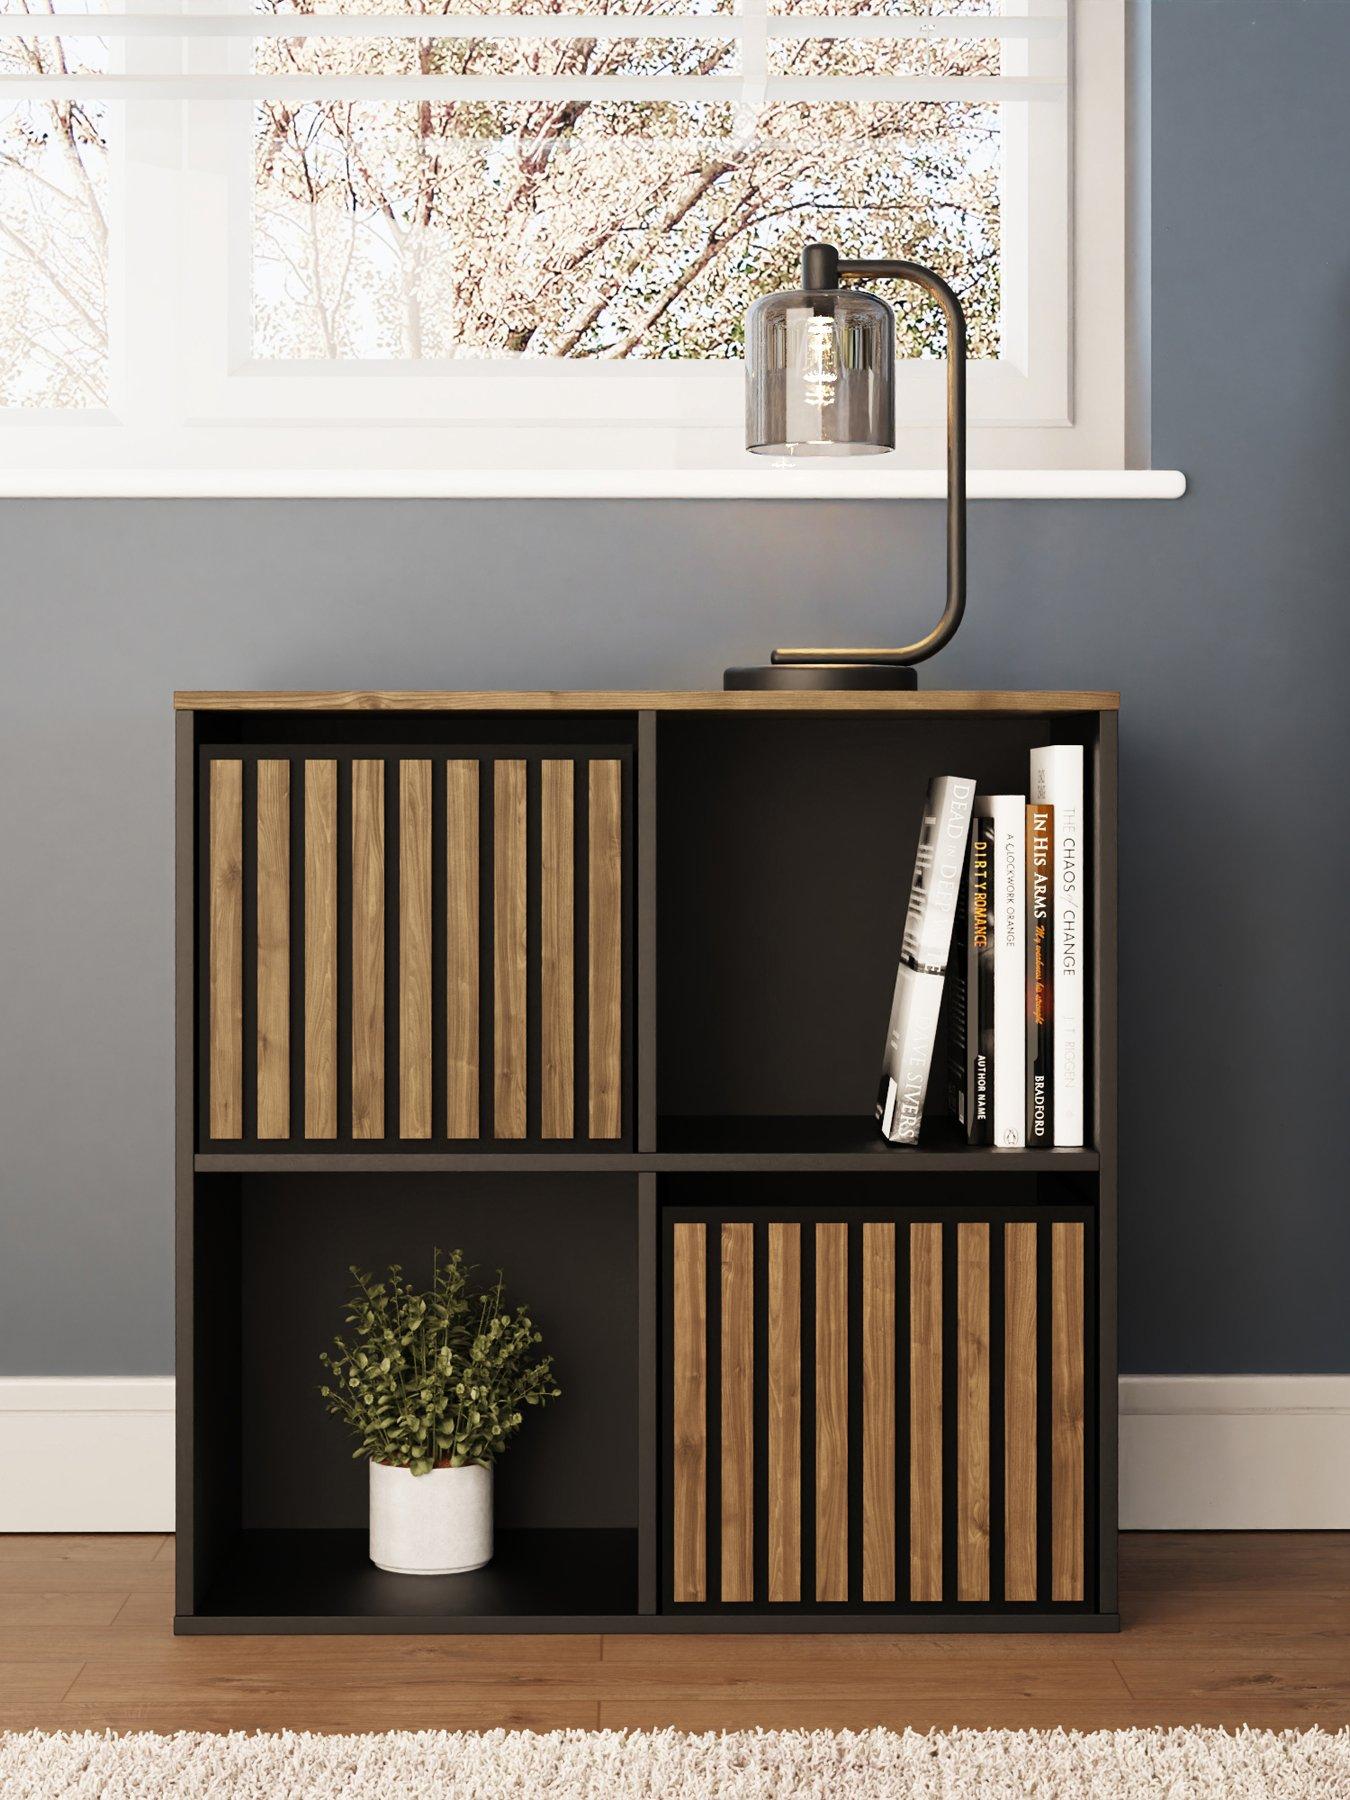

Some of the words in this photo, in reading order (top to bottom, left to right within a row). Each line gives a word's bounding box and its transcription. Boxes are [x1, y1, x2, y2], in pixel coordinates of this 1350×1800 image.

[947, 784, 970, 839] DEAD
[1033, 813, 1048, 832] IN
[1063, 809, 1075, 833] THE
[974, 841, 987, 892] DIRTY
[1005, 842, 1015, 903] CLOCKWORK
[1033, 837, 1048, 867] HIS
[1063, 838, 1075, 893] CHAOS
[974, 892, 988, 948] ROMANCE
[1033, 873, 1047, 919] ARMS
[1006, 907, 1015, 947] ORANGE
[1063, 910, 1075, 976] CHANGE
[911, 1016, 932, 1067] DAVE
[977, 1054, 986, 1093] AUTHOR
[898, 1072, 924, 1138] SIVERS
[977, 1094, 986, 1120] NAME
[1034, 1075, 1045, 1136] BRADFORD
